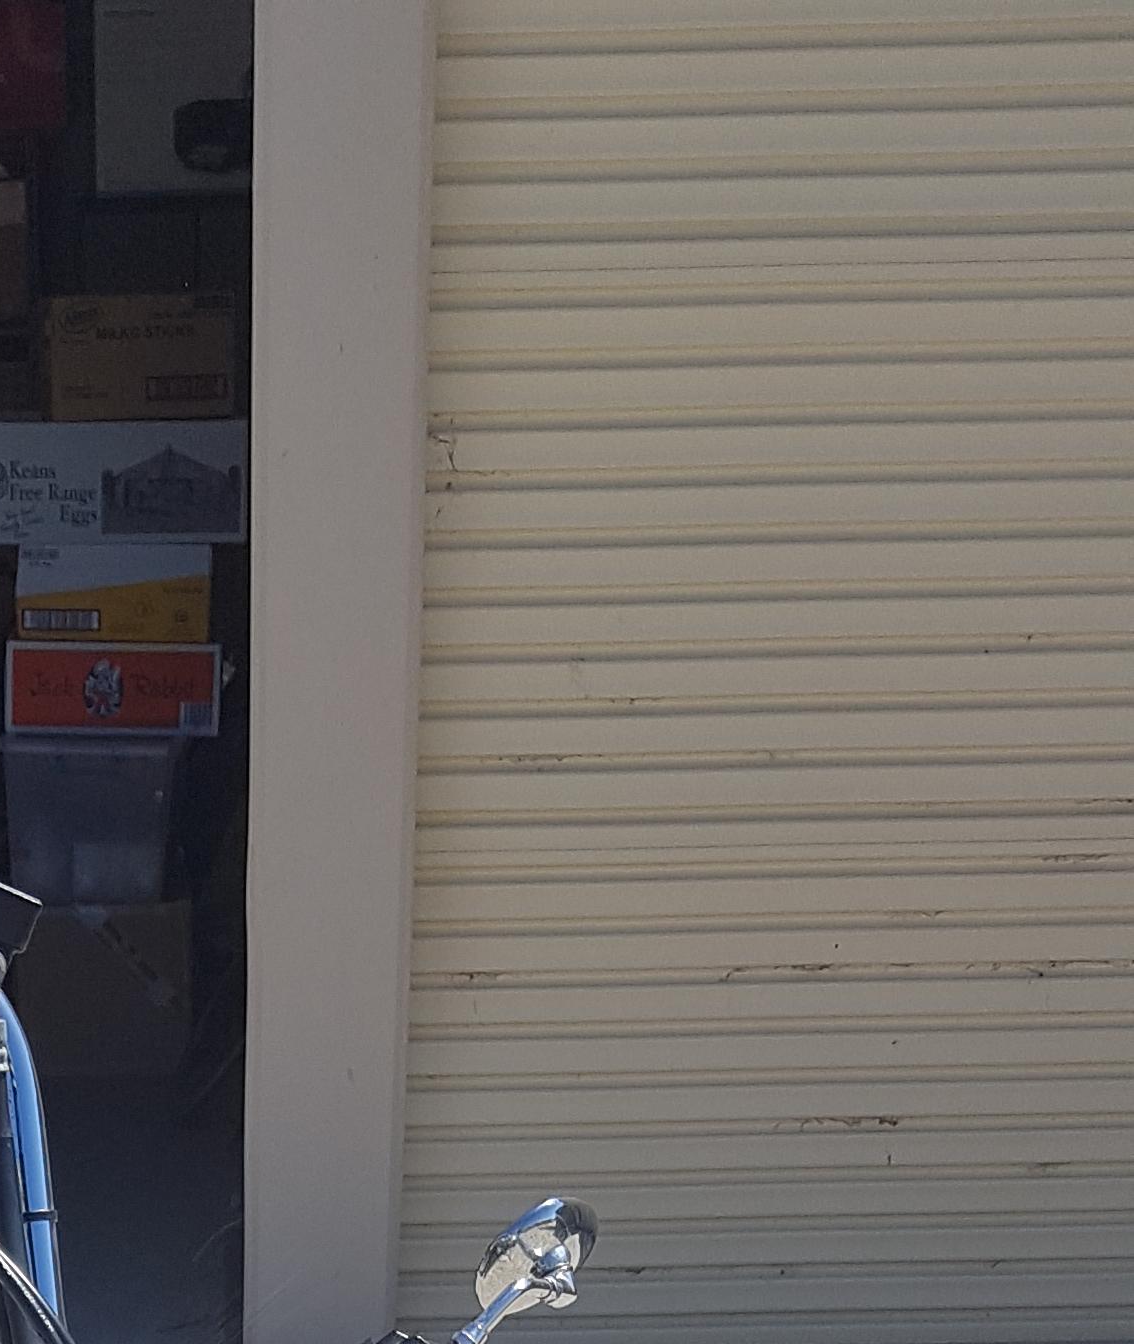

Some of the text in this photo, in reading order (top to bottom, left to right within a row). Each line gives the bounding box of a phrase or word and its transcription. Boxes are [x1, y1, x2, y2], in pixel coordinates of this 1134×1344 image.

[9, 460, 56, 479] Keans
[9, 483, 97, 505] Free Range
[60, 504, 97, 527] Eggs
[129, 672, 195, 698] Rabbit
